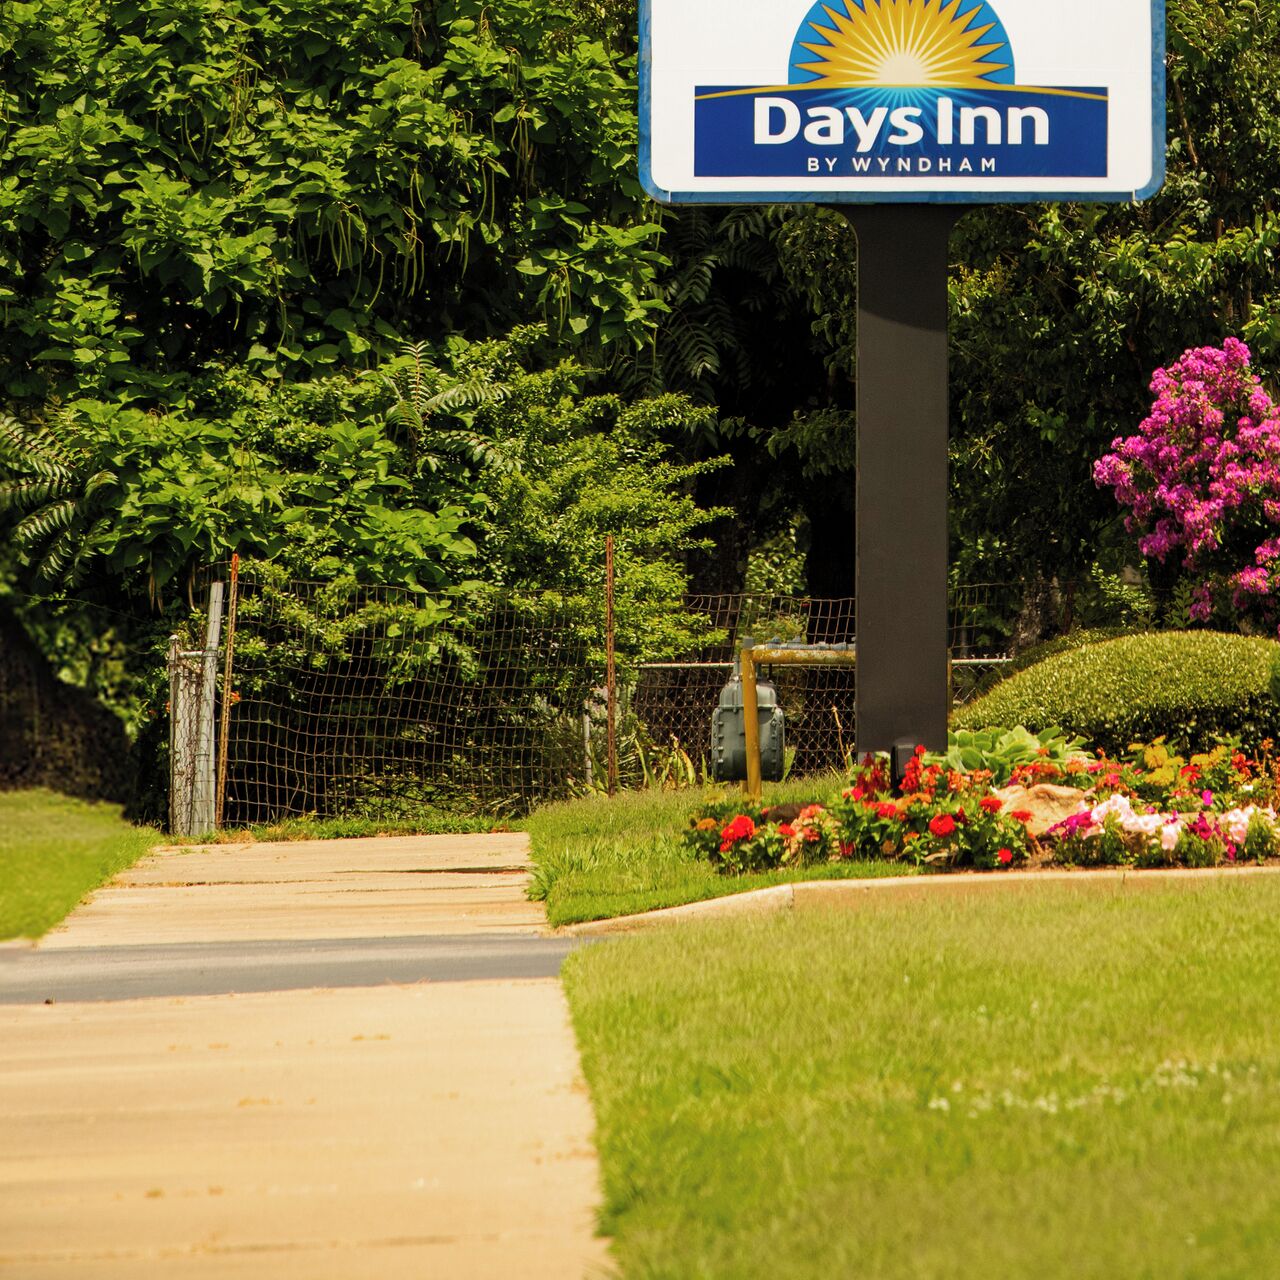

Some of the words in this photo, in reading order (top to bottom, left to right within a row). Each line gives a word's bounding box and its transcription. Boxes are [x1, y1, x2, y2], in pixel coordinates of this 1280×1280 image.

[754, 97, 924, 152] Days
[937, 97, 1049, 145] Inn
[807, 157, 838, 172] BY
[852, 157, 996, 172] WYNDHAM
